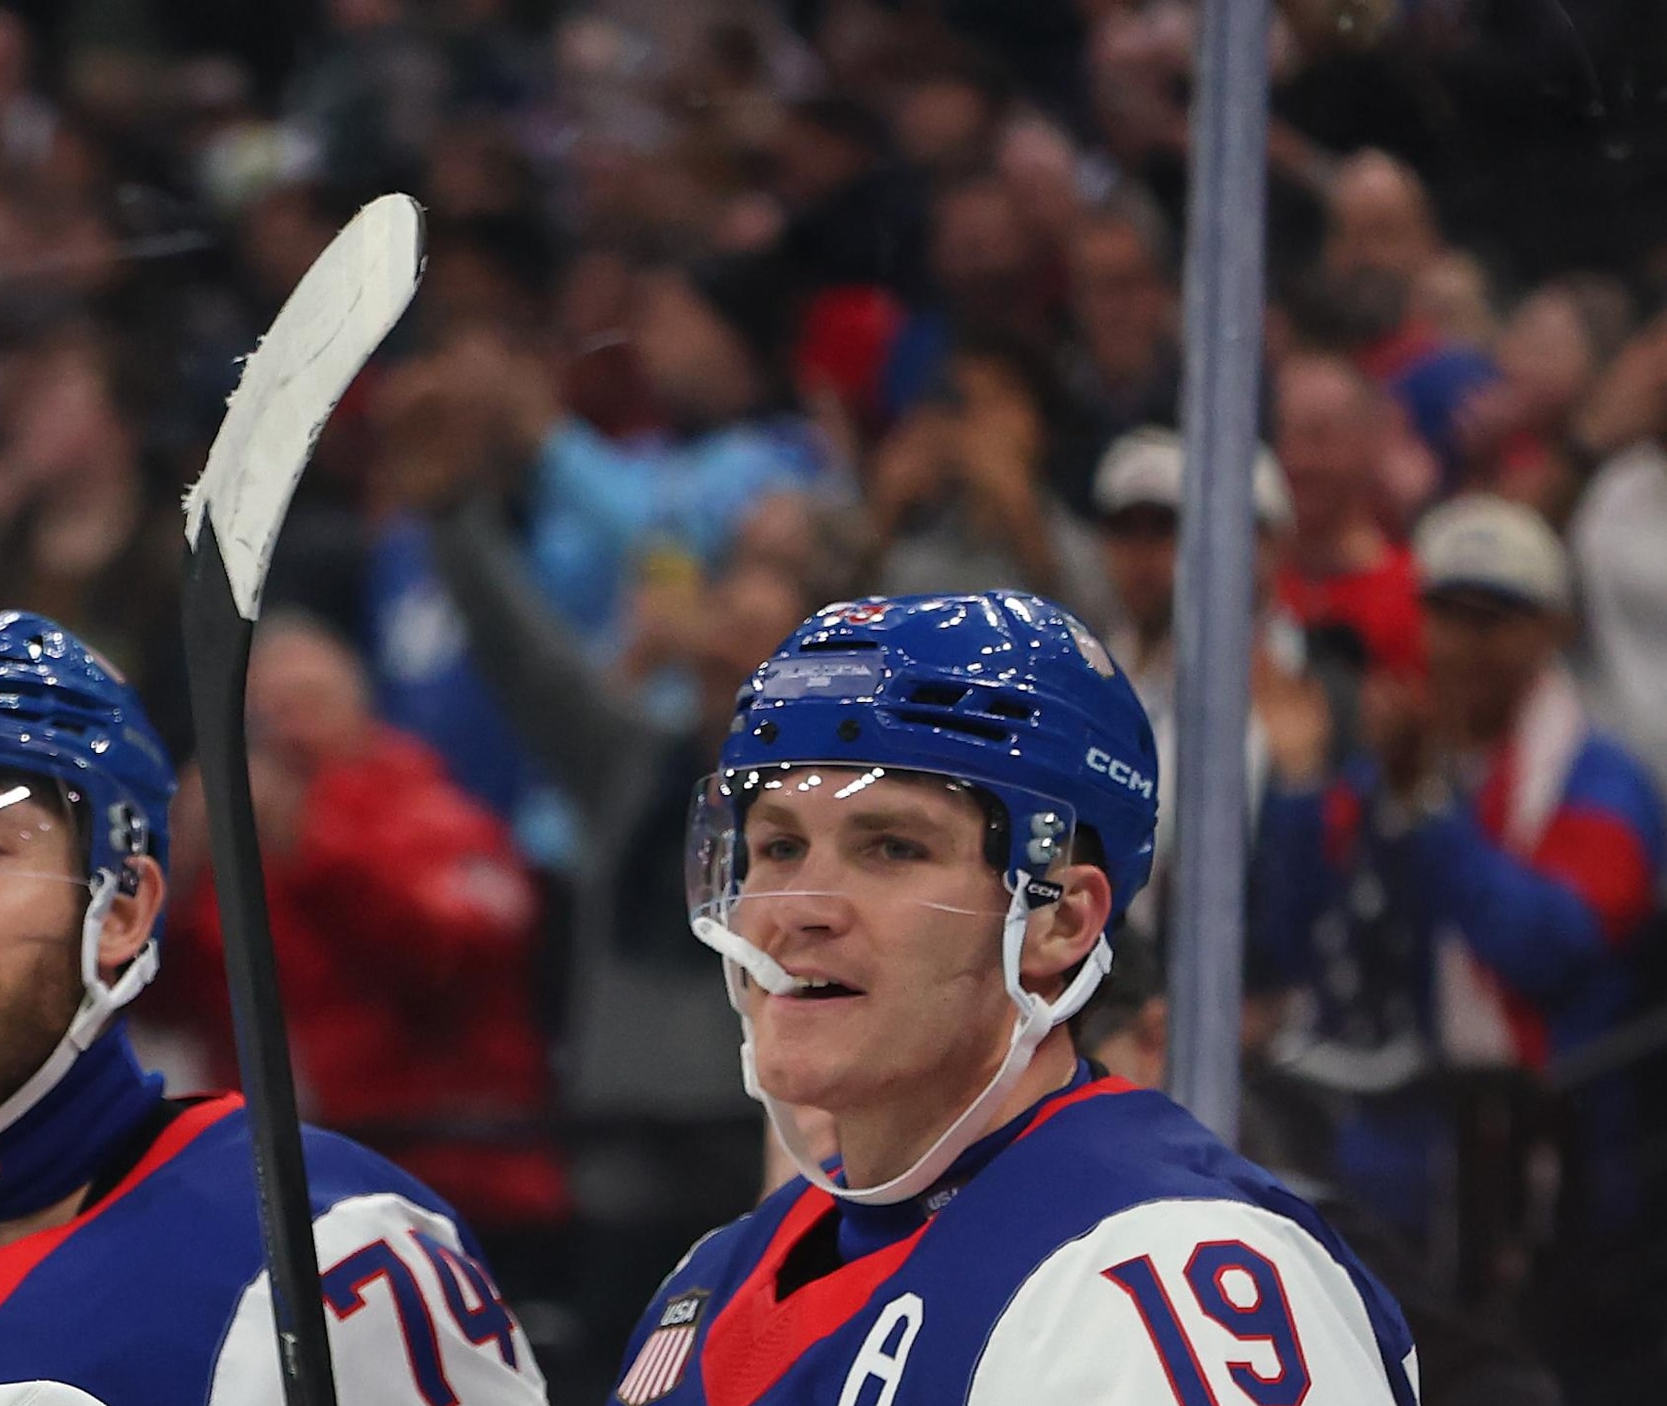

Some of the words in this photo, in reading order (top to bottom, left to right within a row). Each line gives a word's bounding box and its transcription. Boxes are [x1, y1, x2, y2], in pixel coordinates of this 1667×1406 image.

[1086, 747, 1154, 798] CCM
[1028, 883, 1061, 898] CCM
[660, 1301, 696, 1327] USA
